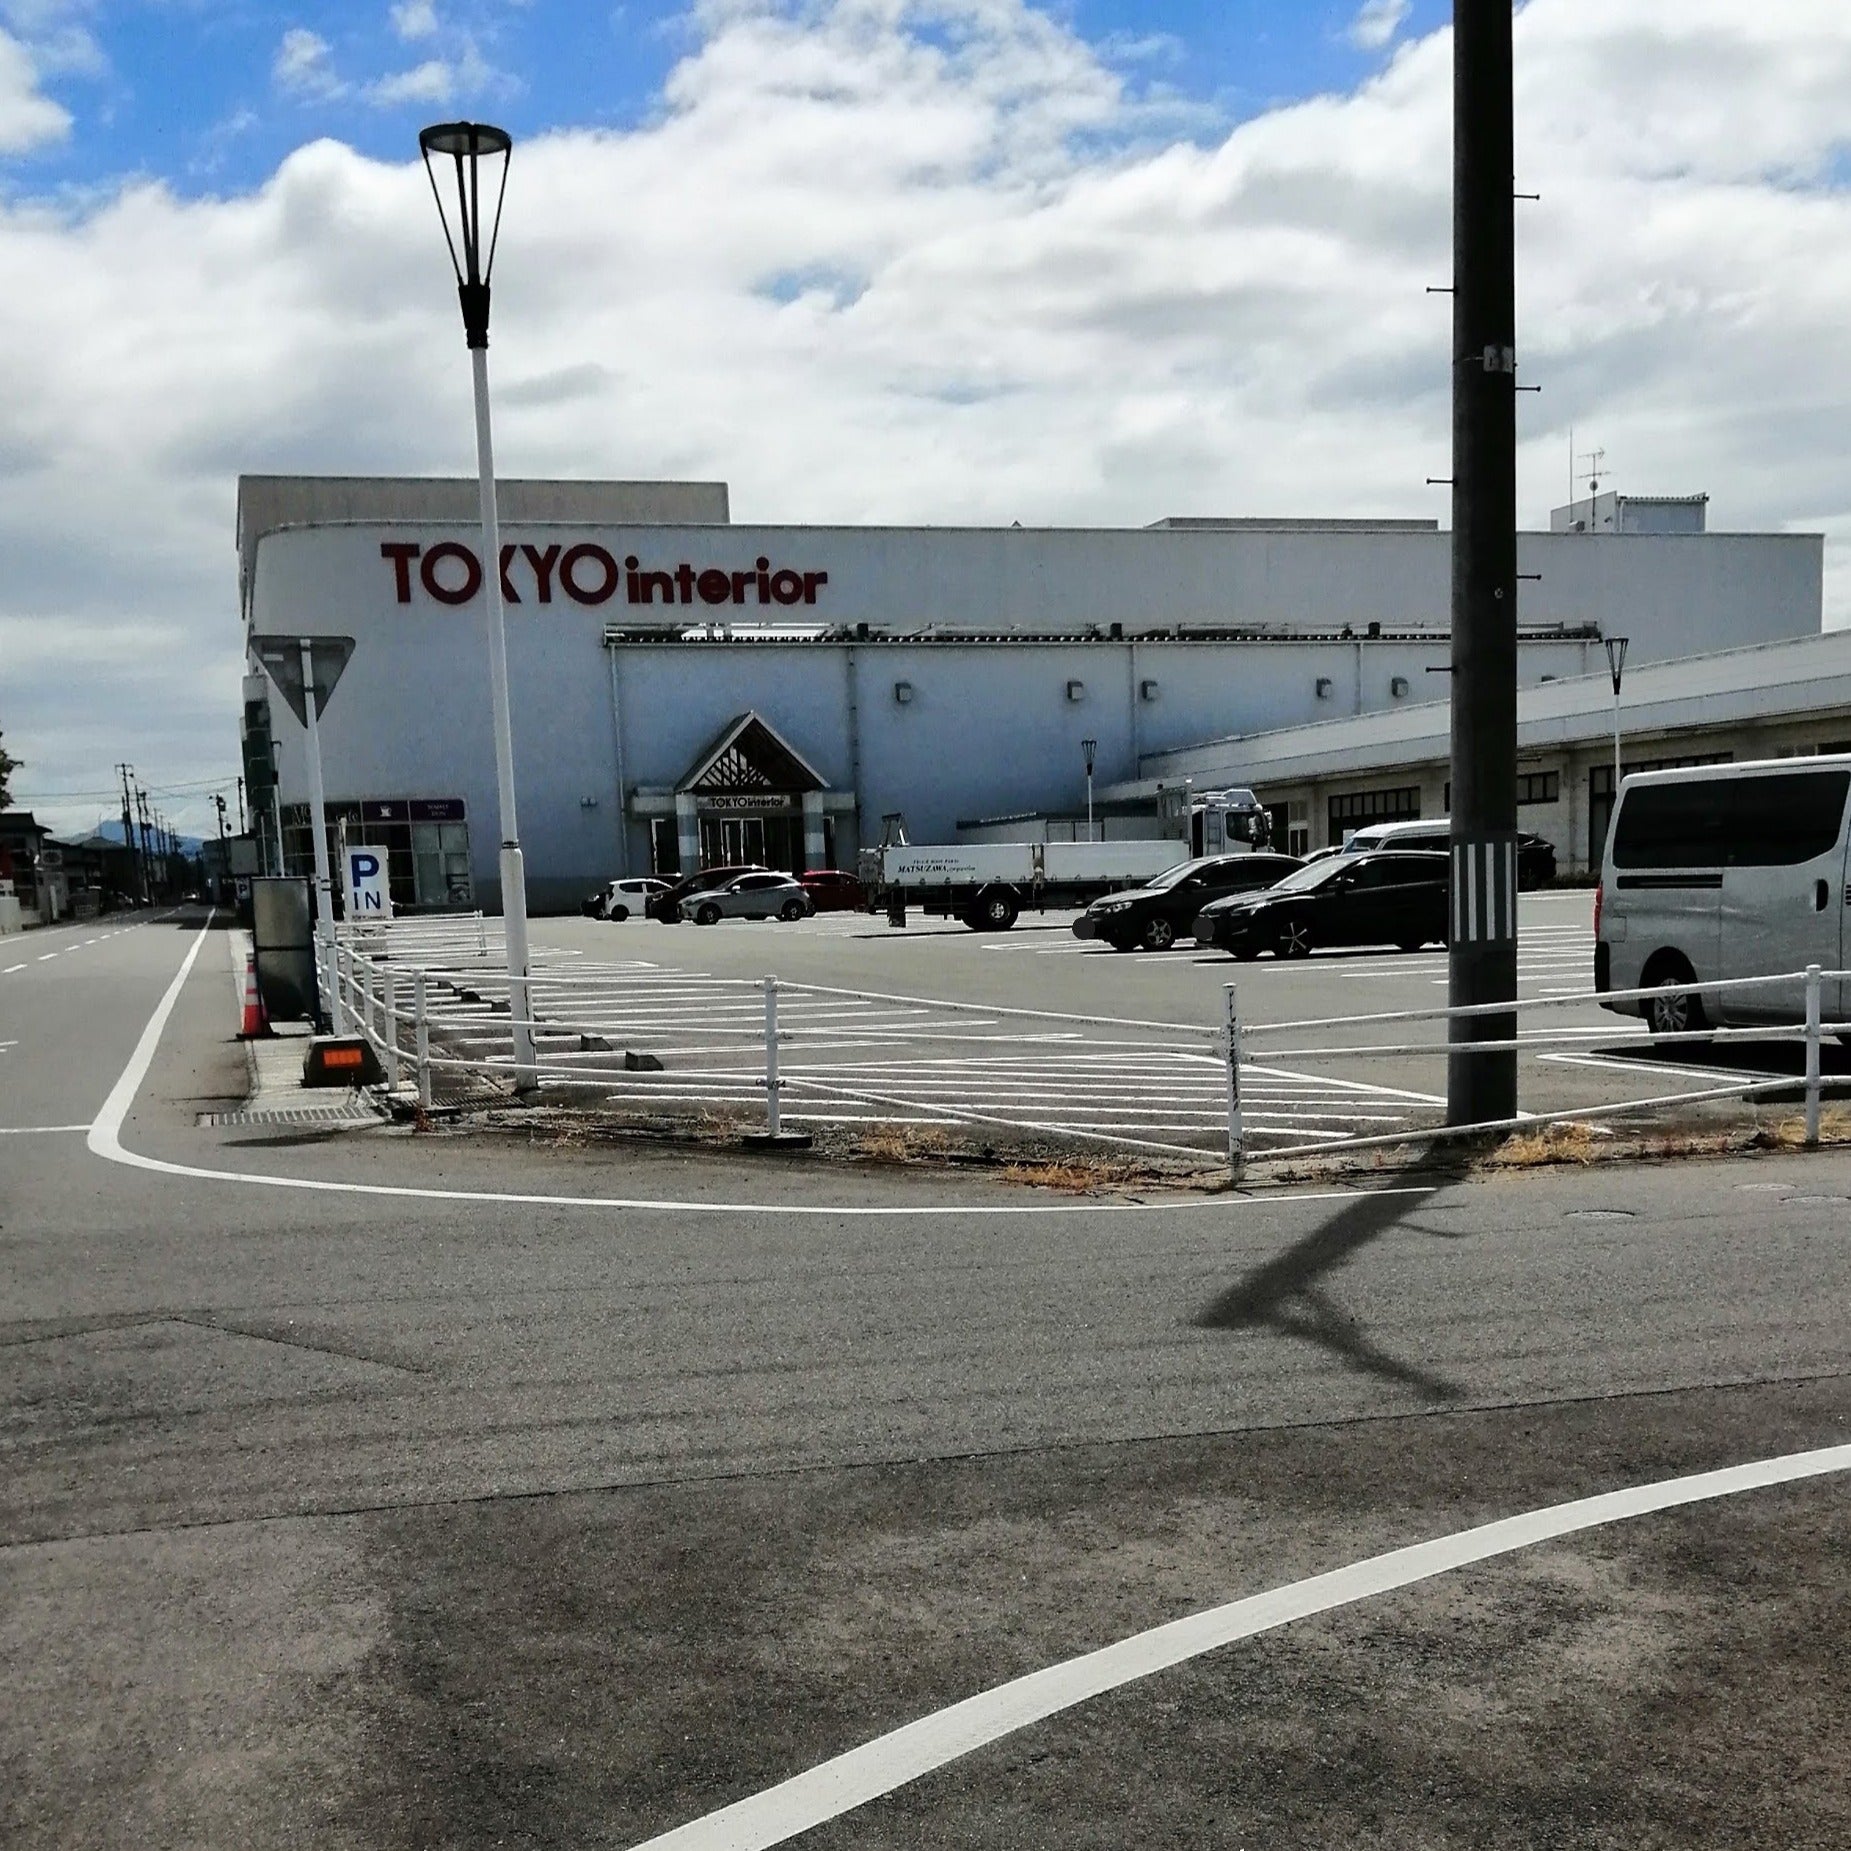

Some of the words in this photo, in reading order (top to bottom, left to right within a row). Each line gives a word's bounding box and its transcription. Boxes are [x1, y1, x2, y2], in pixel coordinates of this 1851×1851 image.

[625, 555, 828, 604] interior
[351, 854, 380, 887] P
[354, 891, 381, 910] IN
